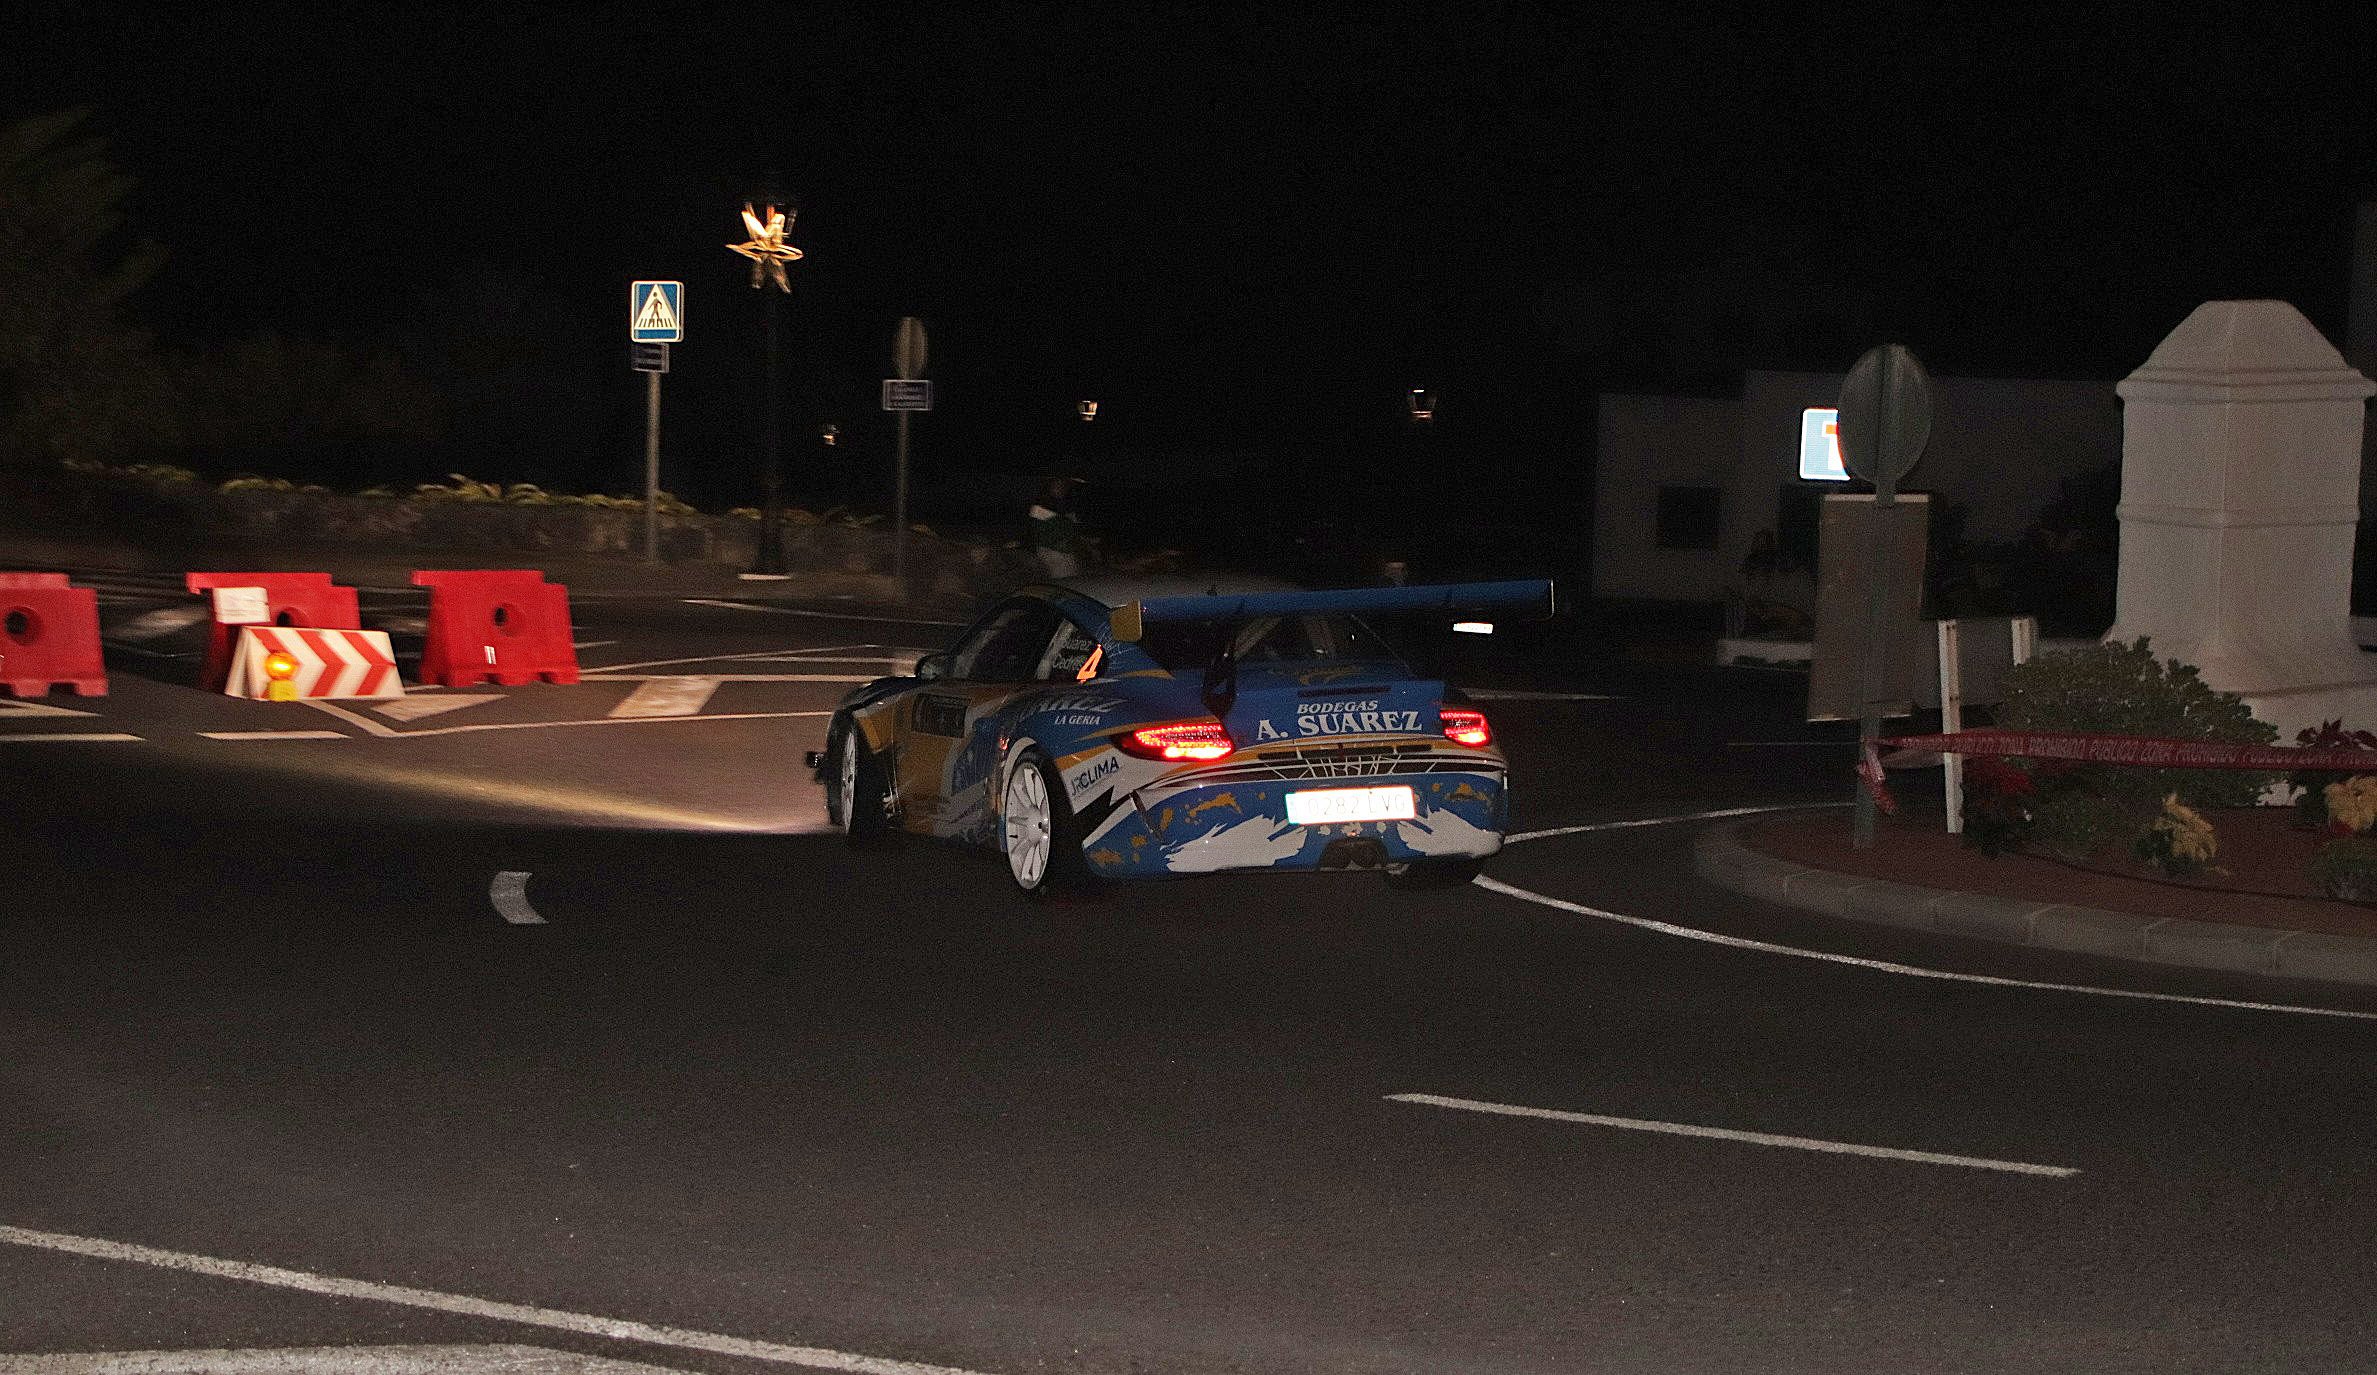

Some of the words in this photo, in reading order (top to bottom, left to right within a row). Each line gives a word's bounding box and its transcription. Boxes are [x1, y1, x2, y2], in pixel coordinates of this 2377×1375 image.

[1076, 643, 1103, 684] 4
[1296, 700, 1379, 714] BODEGAS
[1054, 715, 1066, 725] LA
[1068, 715, 1101, 725] GERIA
[1255, 719, 1289, 741] A.
[1297, 711, 1423, 736] SUAREZ
[1307, 796, 1360, 816] 0282
